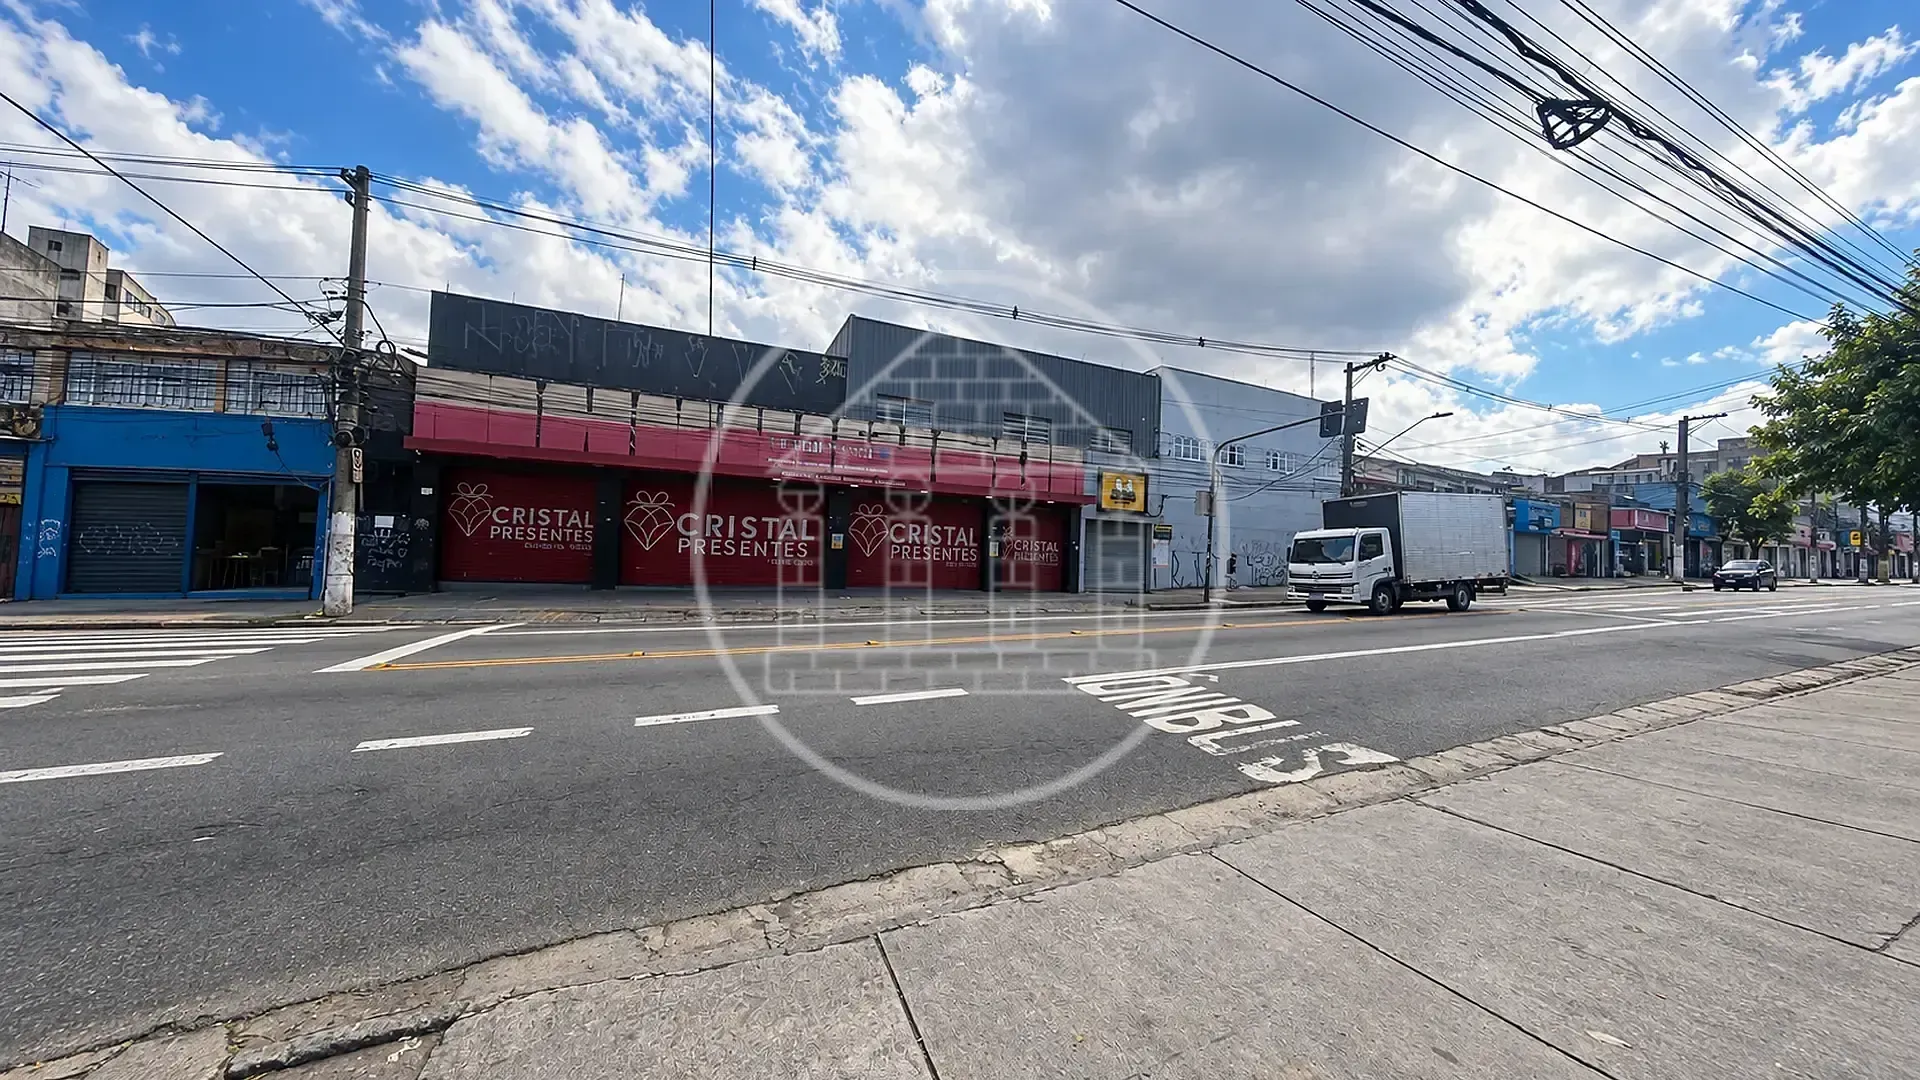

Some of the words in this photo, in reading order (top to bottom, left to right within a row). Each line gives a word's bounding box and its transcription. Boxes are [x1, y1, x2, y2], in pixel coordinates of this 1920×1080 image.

[492, 506, 594, 528] CRISTAL
[676, 513, 815, 541] CRISTAL
[489, 525, 594, 543] PRESENTES
[889, 523, 978, 547] CRISTAL
[678, 538, 809, 558] PRESENTES
[890, 545, 978, 562] PRESENTES
[1013, 539, 1059, 553] CRISTAL
